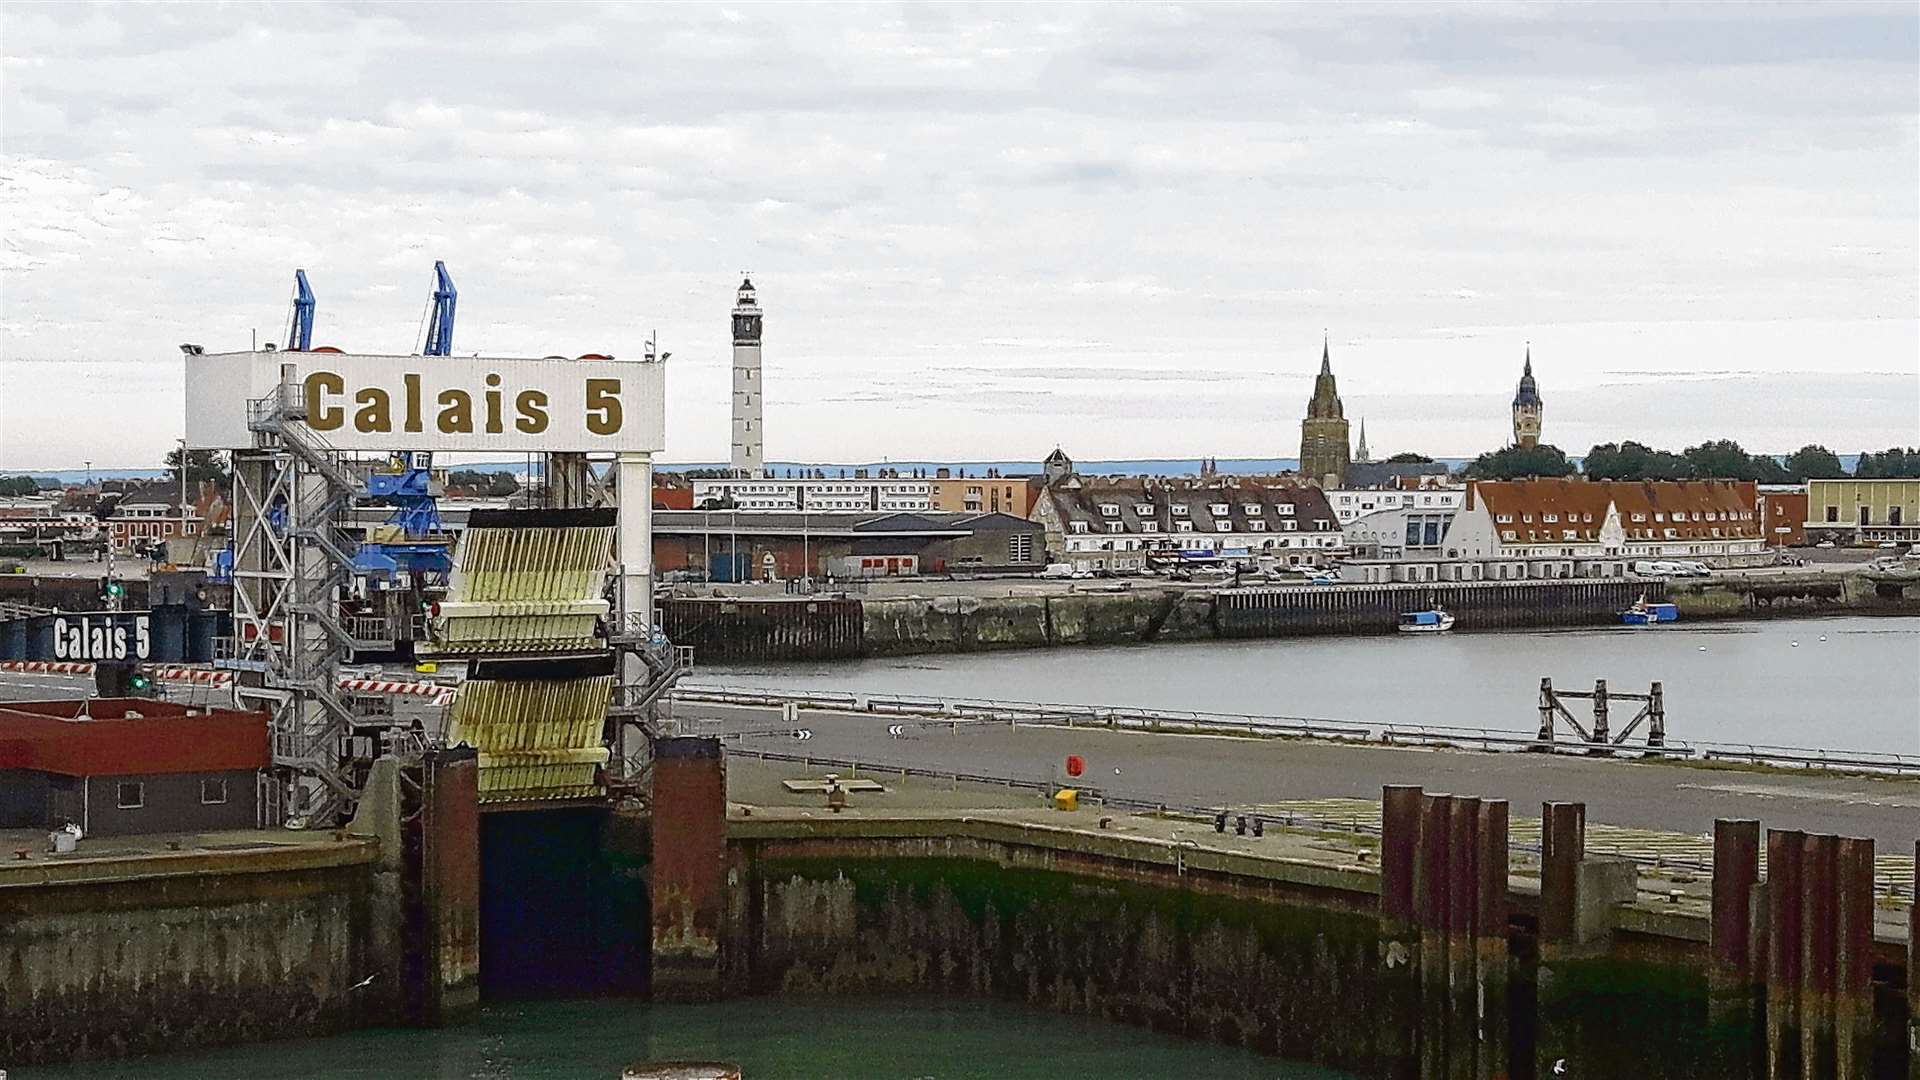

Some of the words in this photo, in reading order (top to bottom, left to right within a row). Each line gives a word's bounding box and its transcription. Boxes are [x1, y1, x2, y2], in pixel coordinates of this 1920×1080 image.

[303, 371, 549, 434] Calais
[585, 378, 623, 436] 5
[54, 617, 127, 660] Calais
[136, 616, 150, 660] 5
